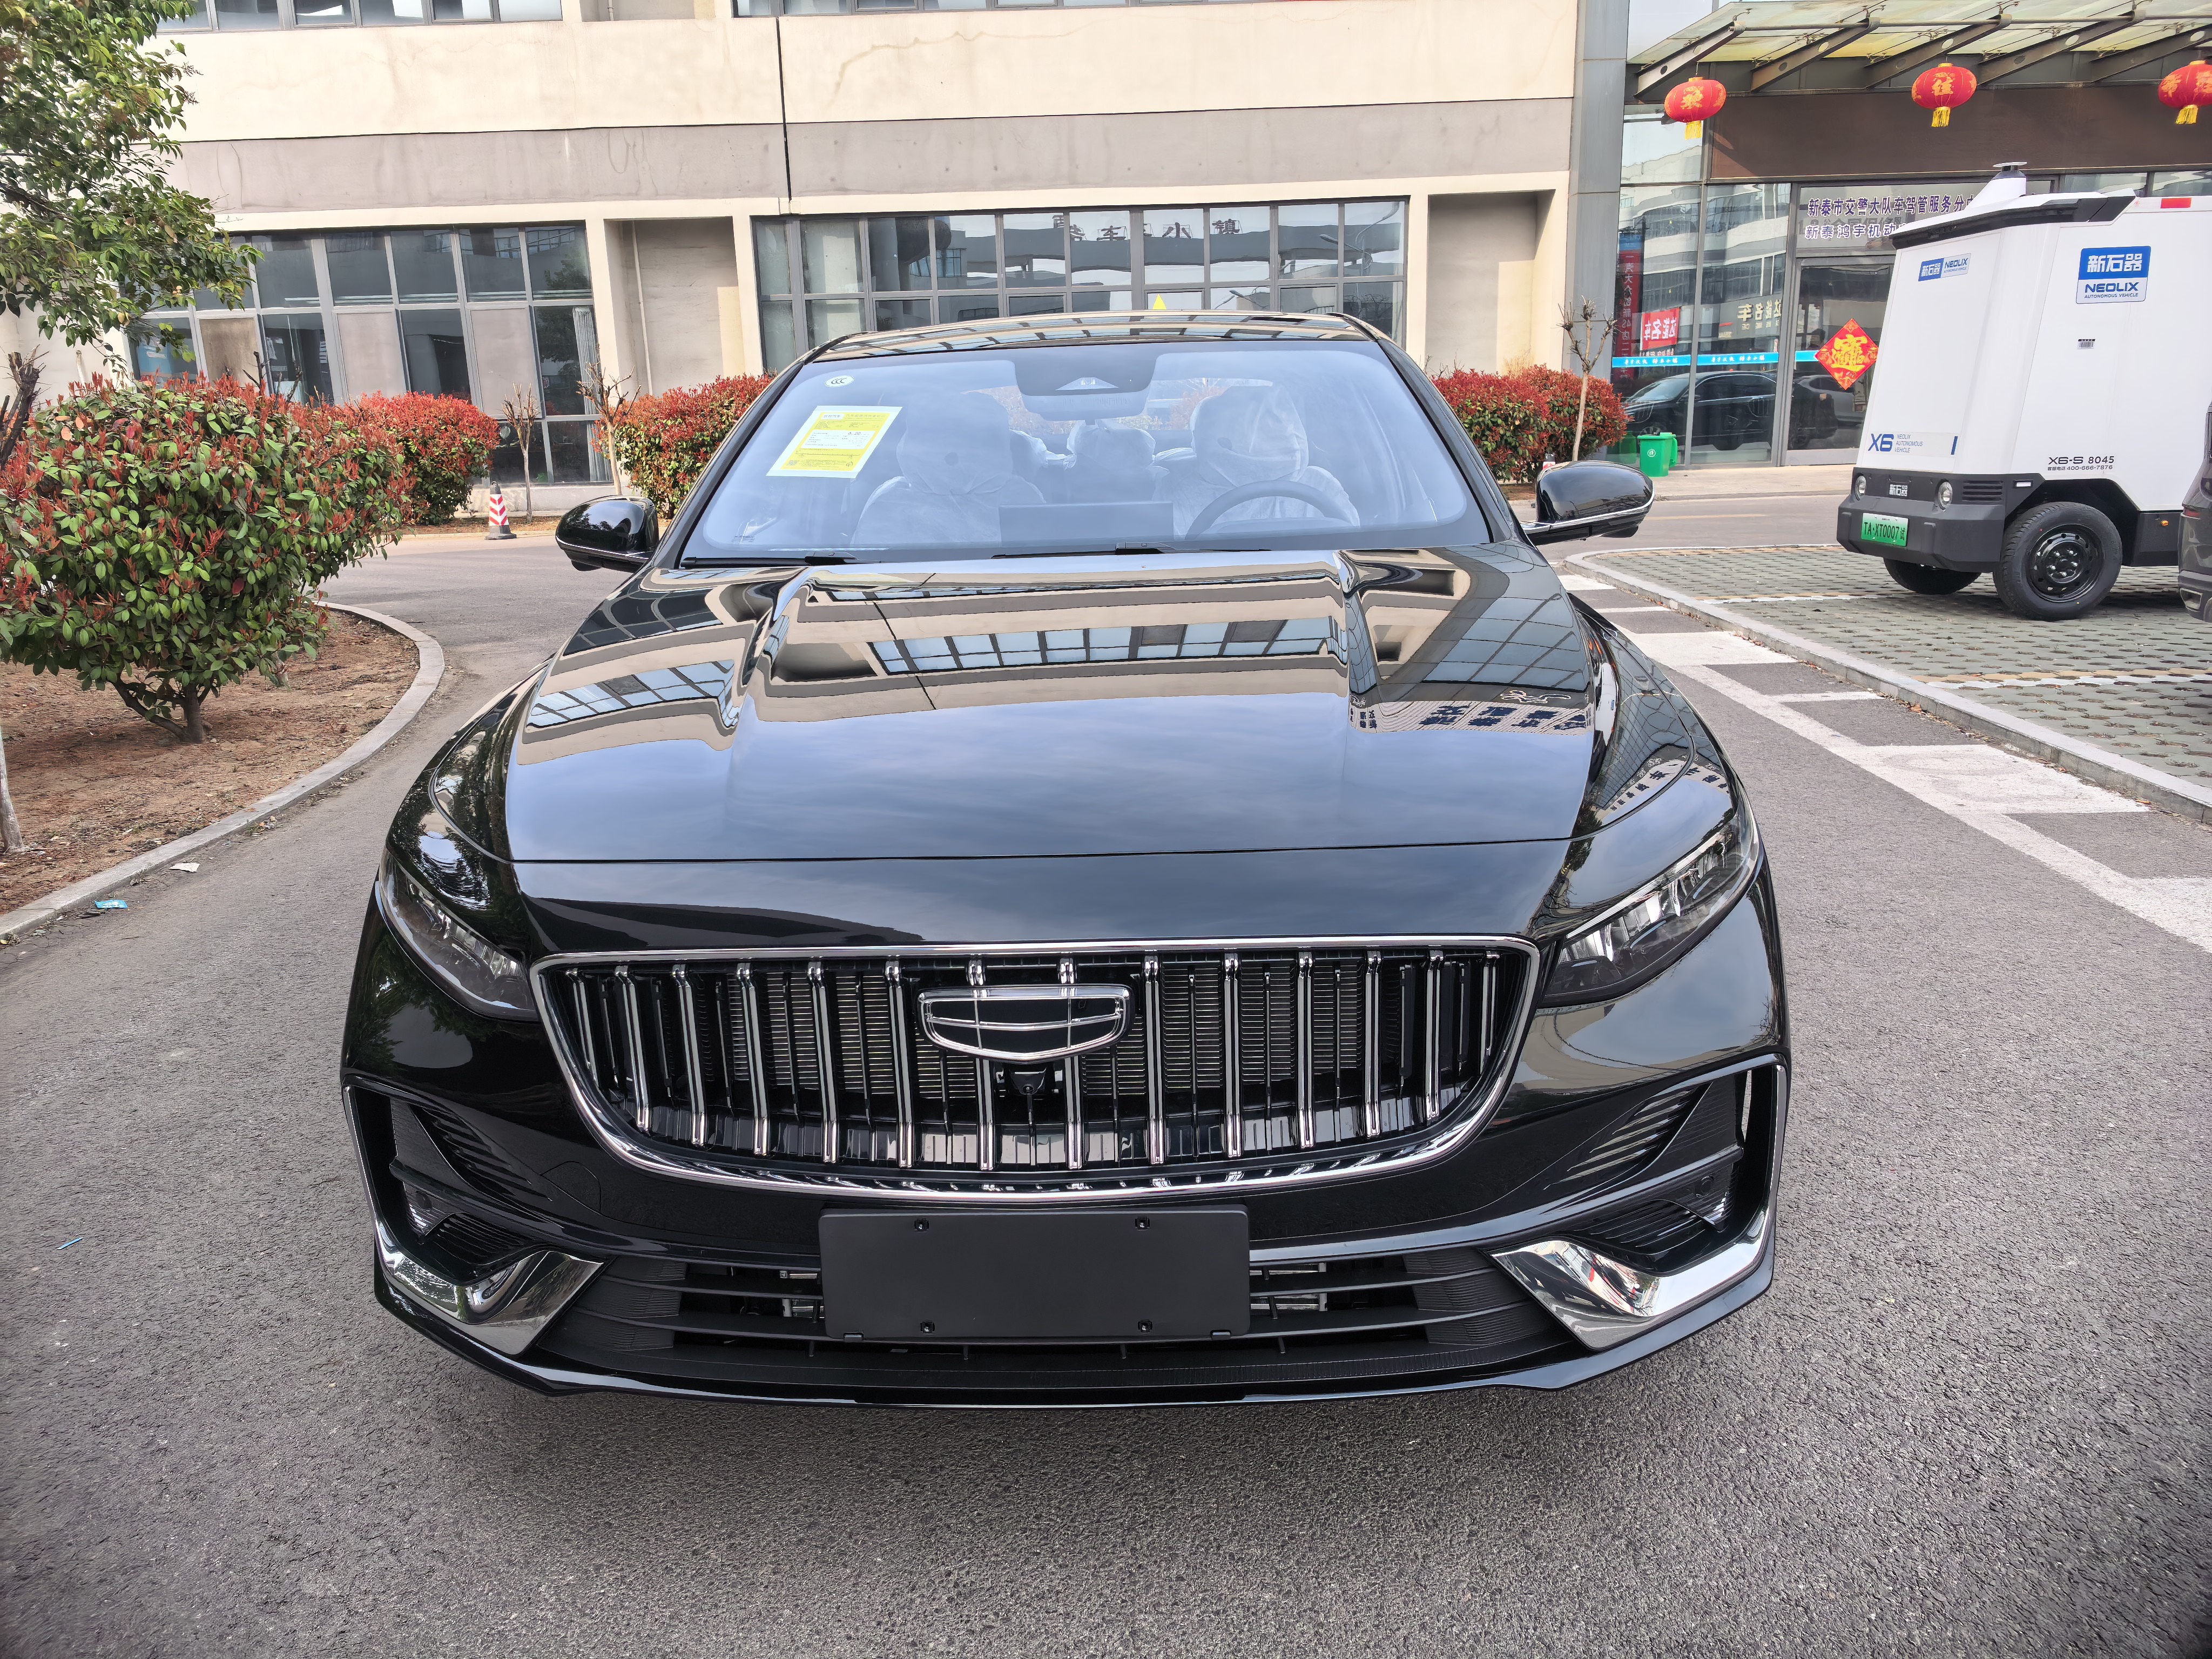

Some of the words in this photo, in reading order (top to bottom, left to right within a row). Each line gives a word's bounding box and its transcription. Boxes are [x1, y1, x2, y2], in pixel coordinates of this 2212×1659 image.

[1805, 224, 1906, 239] 新泰鸿宇机动
[1944, 258, 1968, 268] NEOLIX
[2087, 253, 2142, 273] 新石器
[1921, 263, 1941, 276] 新石器
[2085, 282, 2140, 293] NEOLIX
[1867, 433, 1894, 452] X6
[2048, 456, 2083, 465] X6-S
[2088, 456, 2114, 464] 8045
[1889, 484, 1908, 496] 新石器
